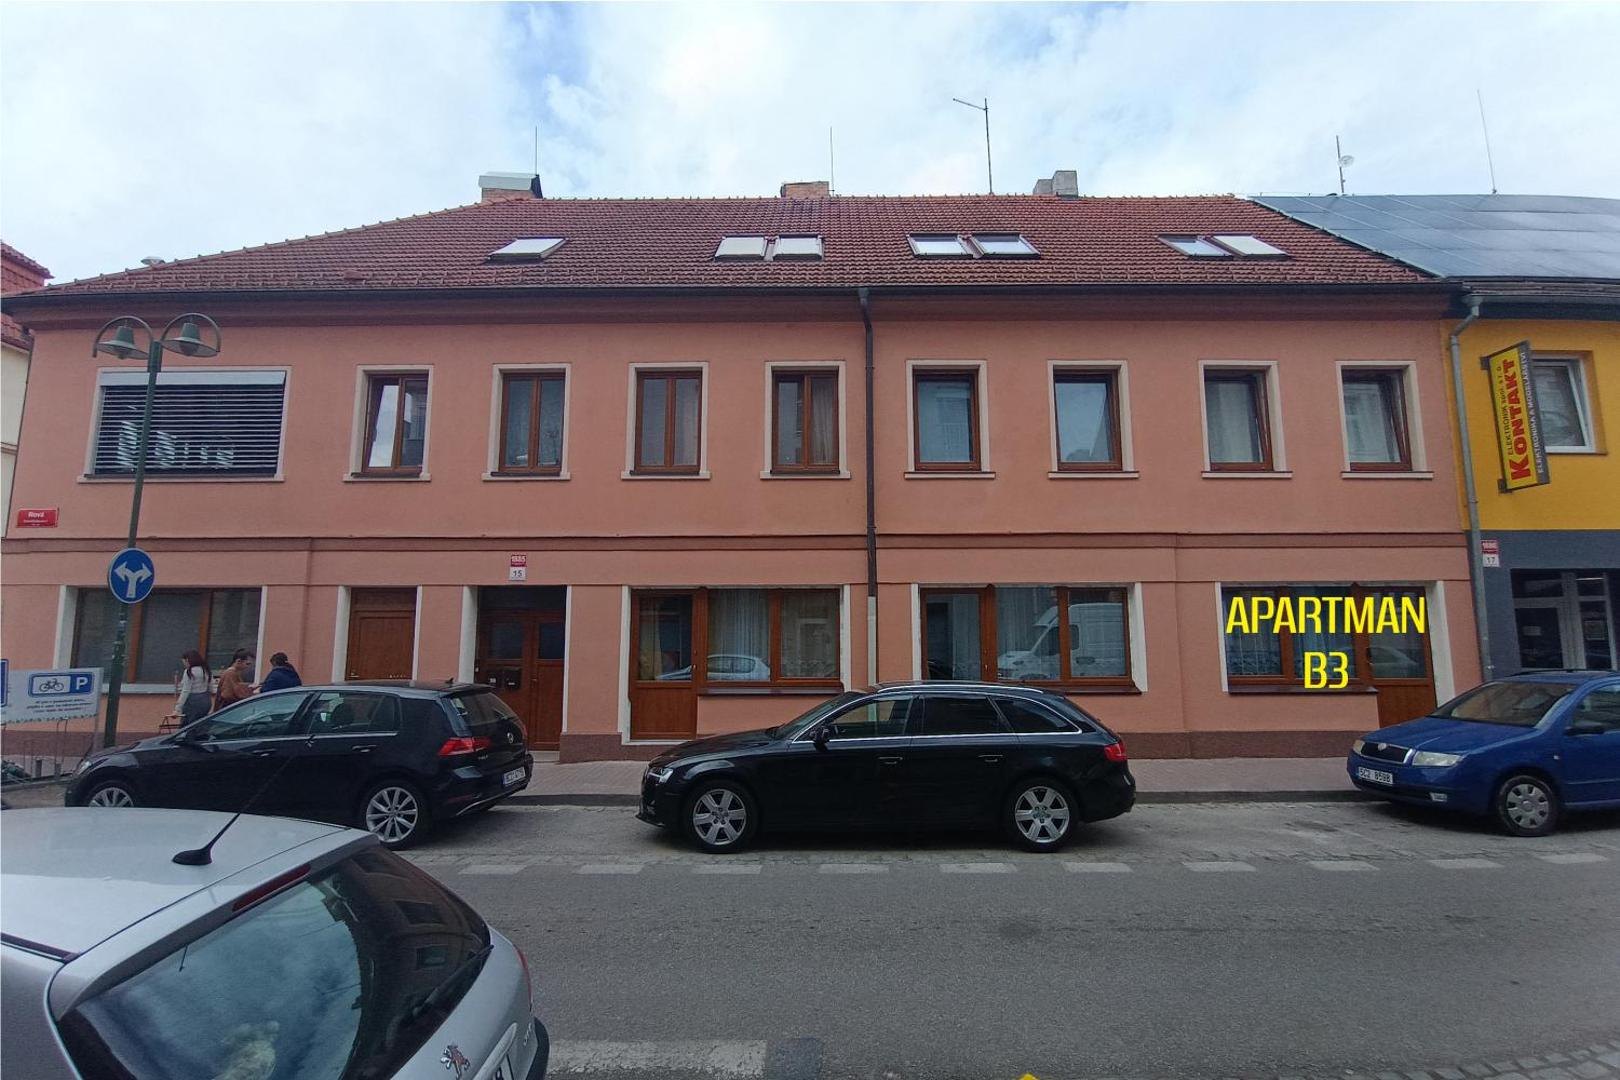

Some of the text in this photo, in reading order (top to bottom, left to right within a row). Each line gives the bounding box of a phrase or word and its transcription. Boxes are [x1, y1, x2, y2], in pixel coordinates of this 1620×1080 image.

[1503, 359, 1531, 480] KONTAKT
[1486, 556, 1496, 564] 17
[512, 570, 523, 578] 15
[75, 677, 89, 690] P
